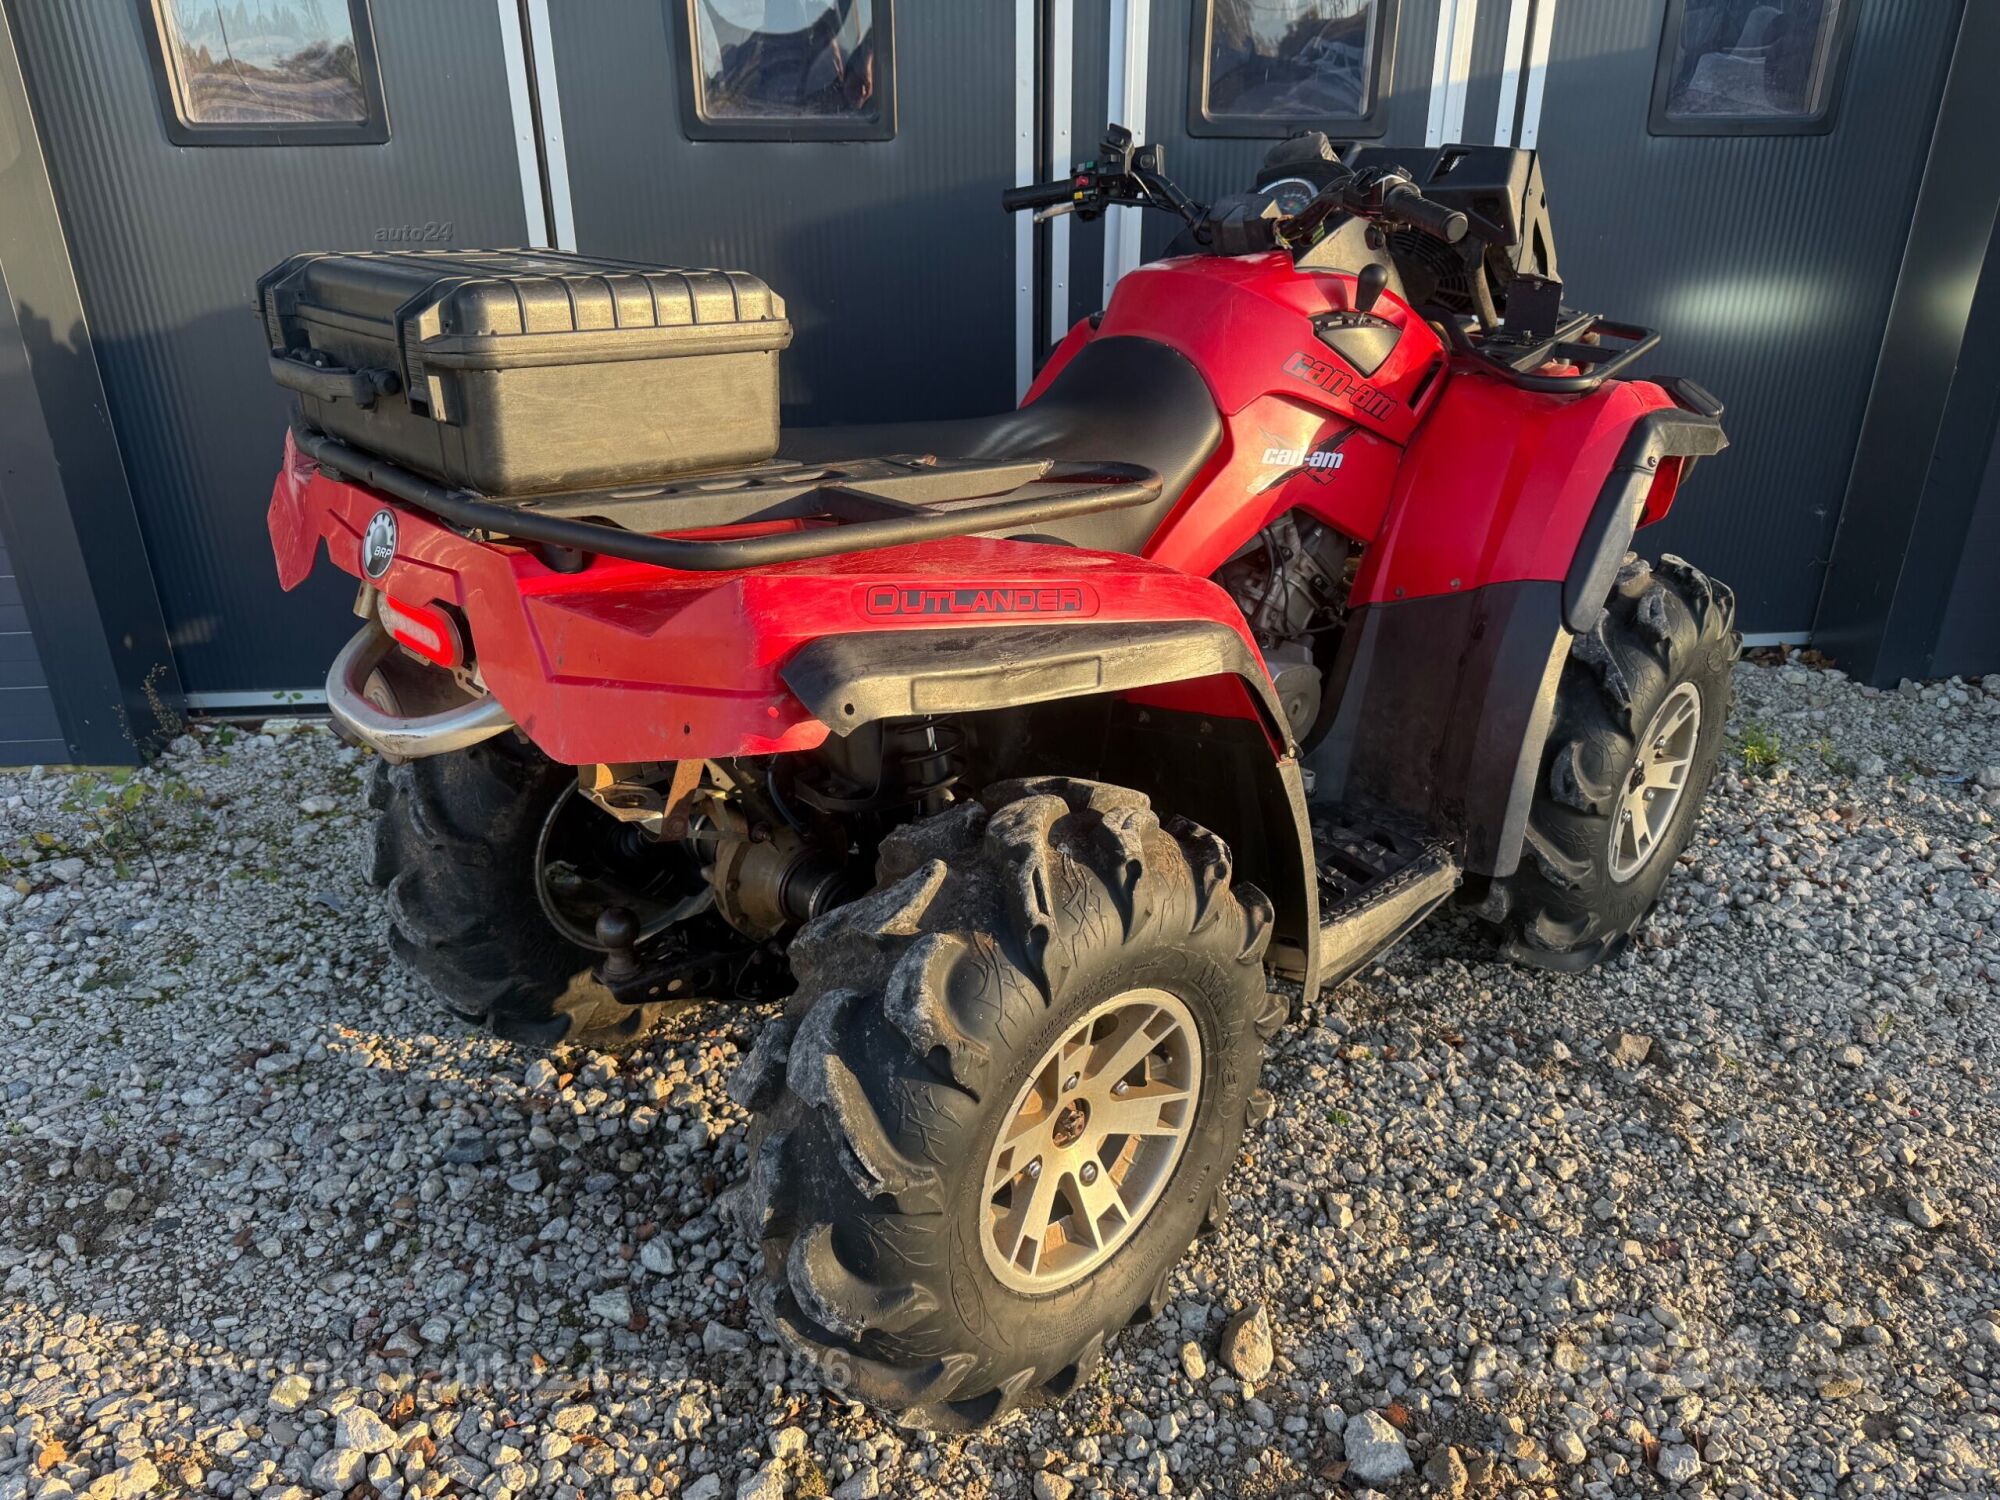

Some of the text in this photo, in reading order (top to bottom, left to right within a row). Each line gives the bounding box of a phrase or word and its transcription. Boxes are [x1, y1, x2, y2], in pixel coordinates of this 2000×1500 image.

[1281, 350, 1399, 423] can-am
[1261, 447, 1345, 470] can-am
[374, 545, 392, 559] BRP
[866, 584, 1082, 616] OUTLANDER
